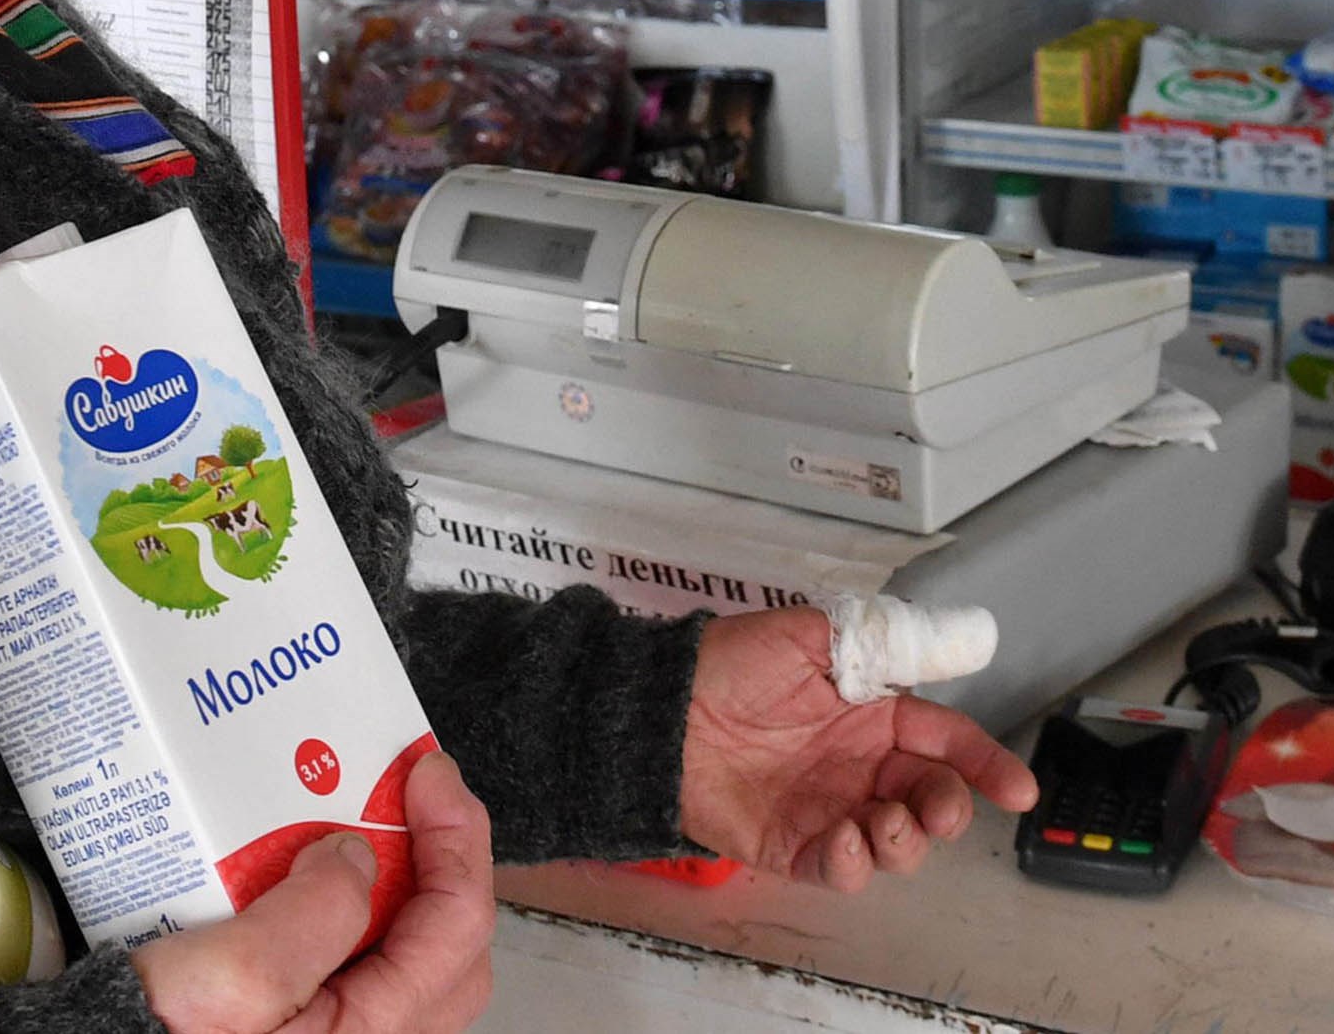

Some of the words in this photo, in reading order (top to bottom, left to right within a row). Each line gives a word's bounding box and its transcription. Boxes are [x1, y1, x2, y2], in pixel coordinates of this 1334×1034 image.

[72, 374, 189, 433] Савушкин
[141, 440, 178, 462] свежего
[176, 411, 202, 443] молока
[414, 503, 594, 571] Считайте
[607, 550, 749, 604] деньги
[761, 584, 811, 609] не
[9, 631, 35, 657] МАЙ
[300, 758, 323, 782] 3,1
[321, 751, 336, 770] %
[41, 807, 74, 832] YAĞIN
[74, 794, 111, 819] KÜTLƏ
[146, 814, 170, 837] SÜD
[46, 829, 75, 851] OLAN
